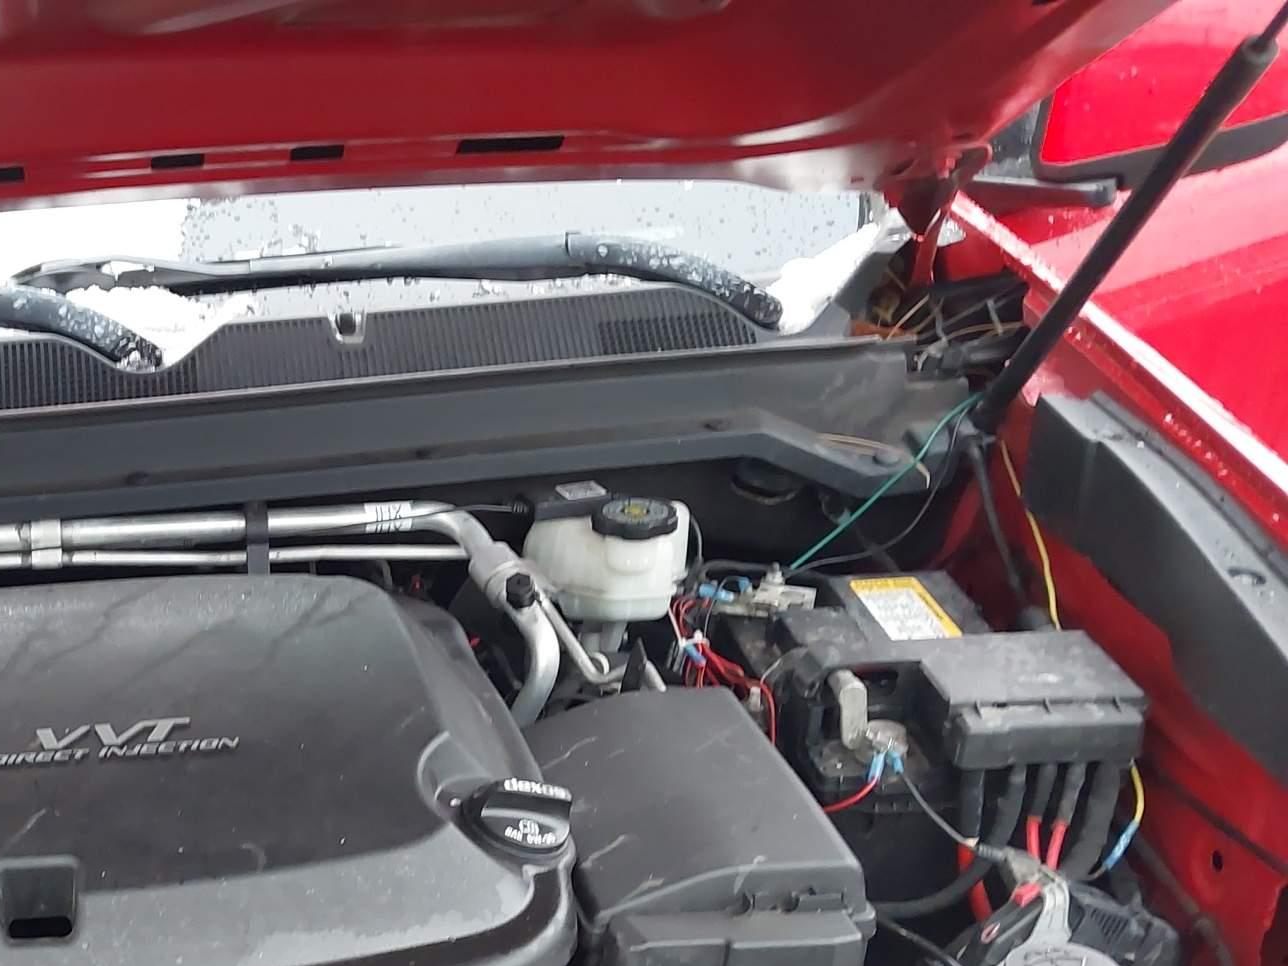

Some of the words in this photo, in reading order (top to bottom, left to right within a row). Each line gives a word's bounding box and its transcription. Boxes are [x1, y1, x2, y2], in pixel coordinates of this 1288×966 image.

[35, 716, 191, 751] VVT
[98, 735, 240, 759] INJECTION
[503, 777, 572, 801] dexos
